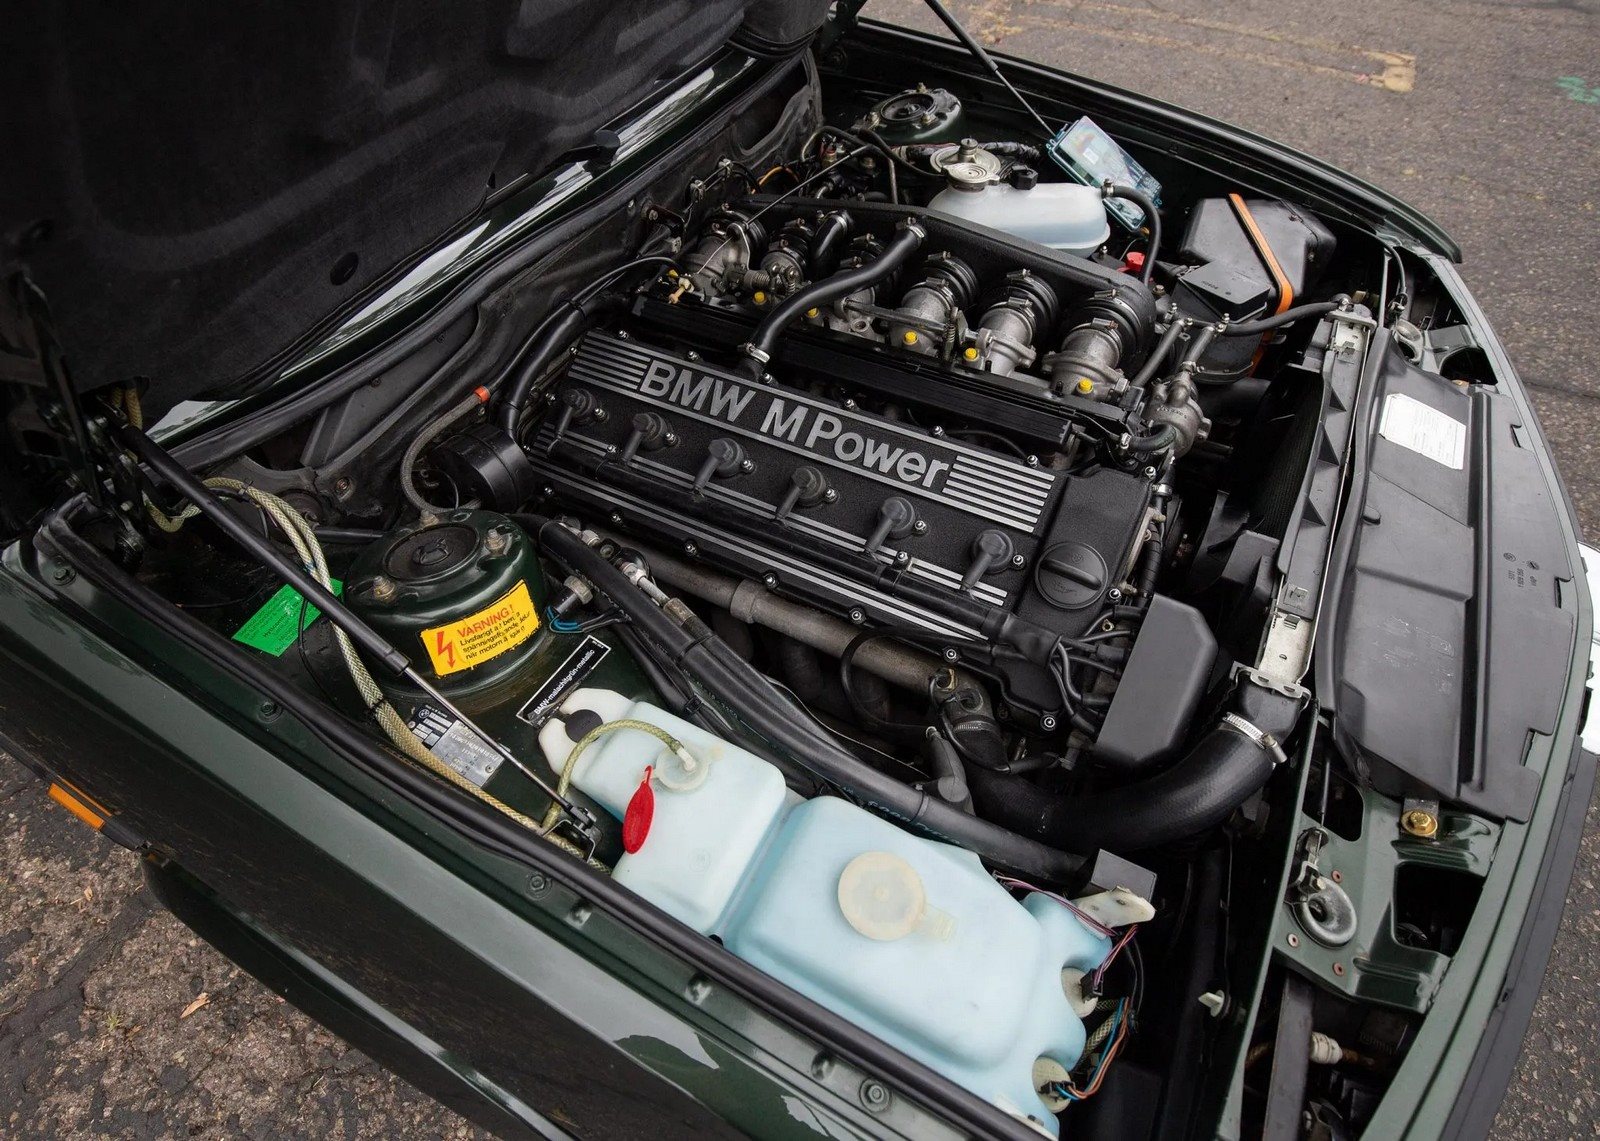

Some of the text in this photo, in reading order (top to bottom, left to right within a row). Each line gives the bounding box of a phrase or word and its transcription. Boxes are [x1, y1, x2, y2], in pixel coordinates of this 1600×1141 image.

[639, 359, 757, 423] BMW
[460, 628, 493, 646] Livsfargt
[533, 649, 595, 715] BMW-malachitgrün-metallic
